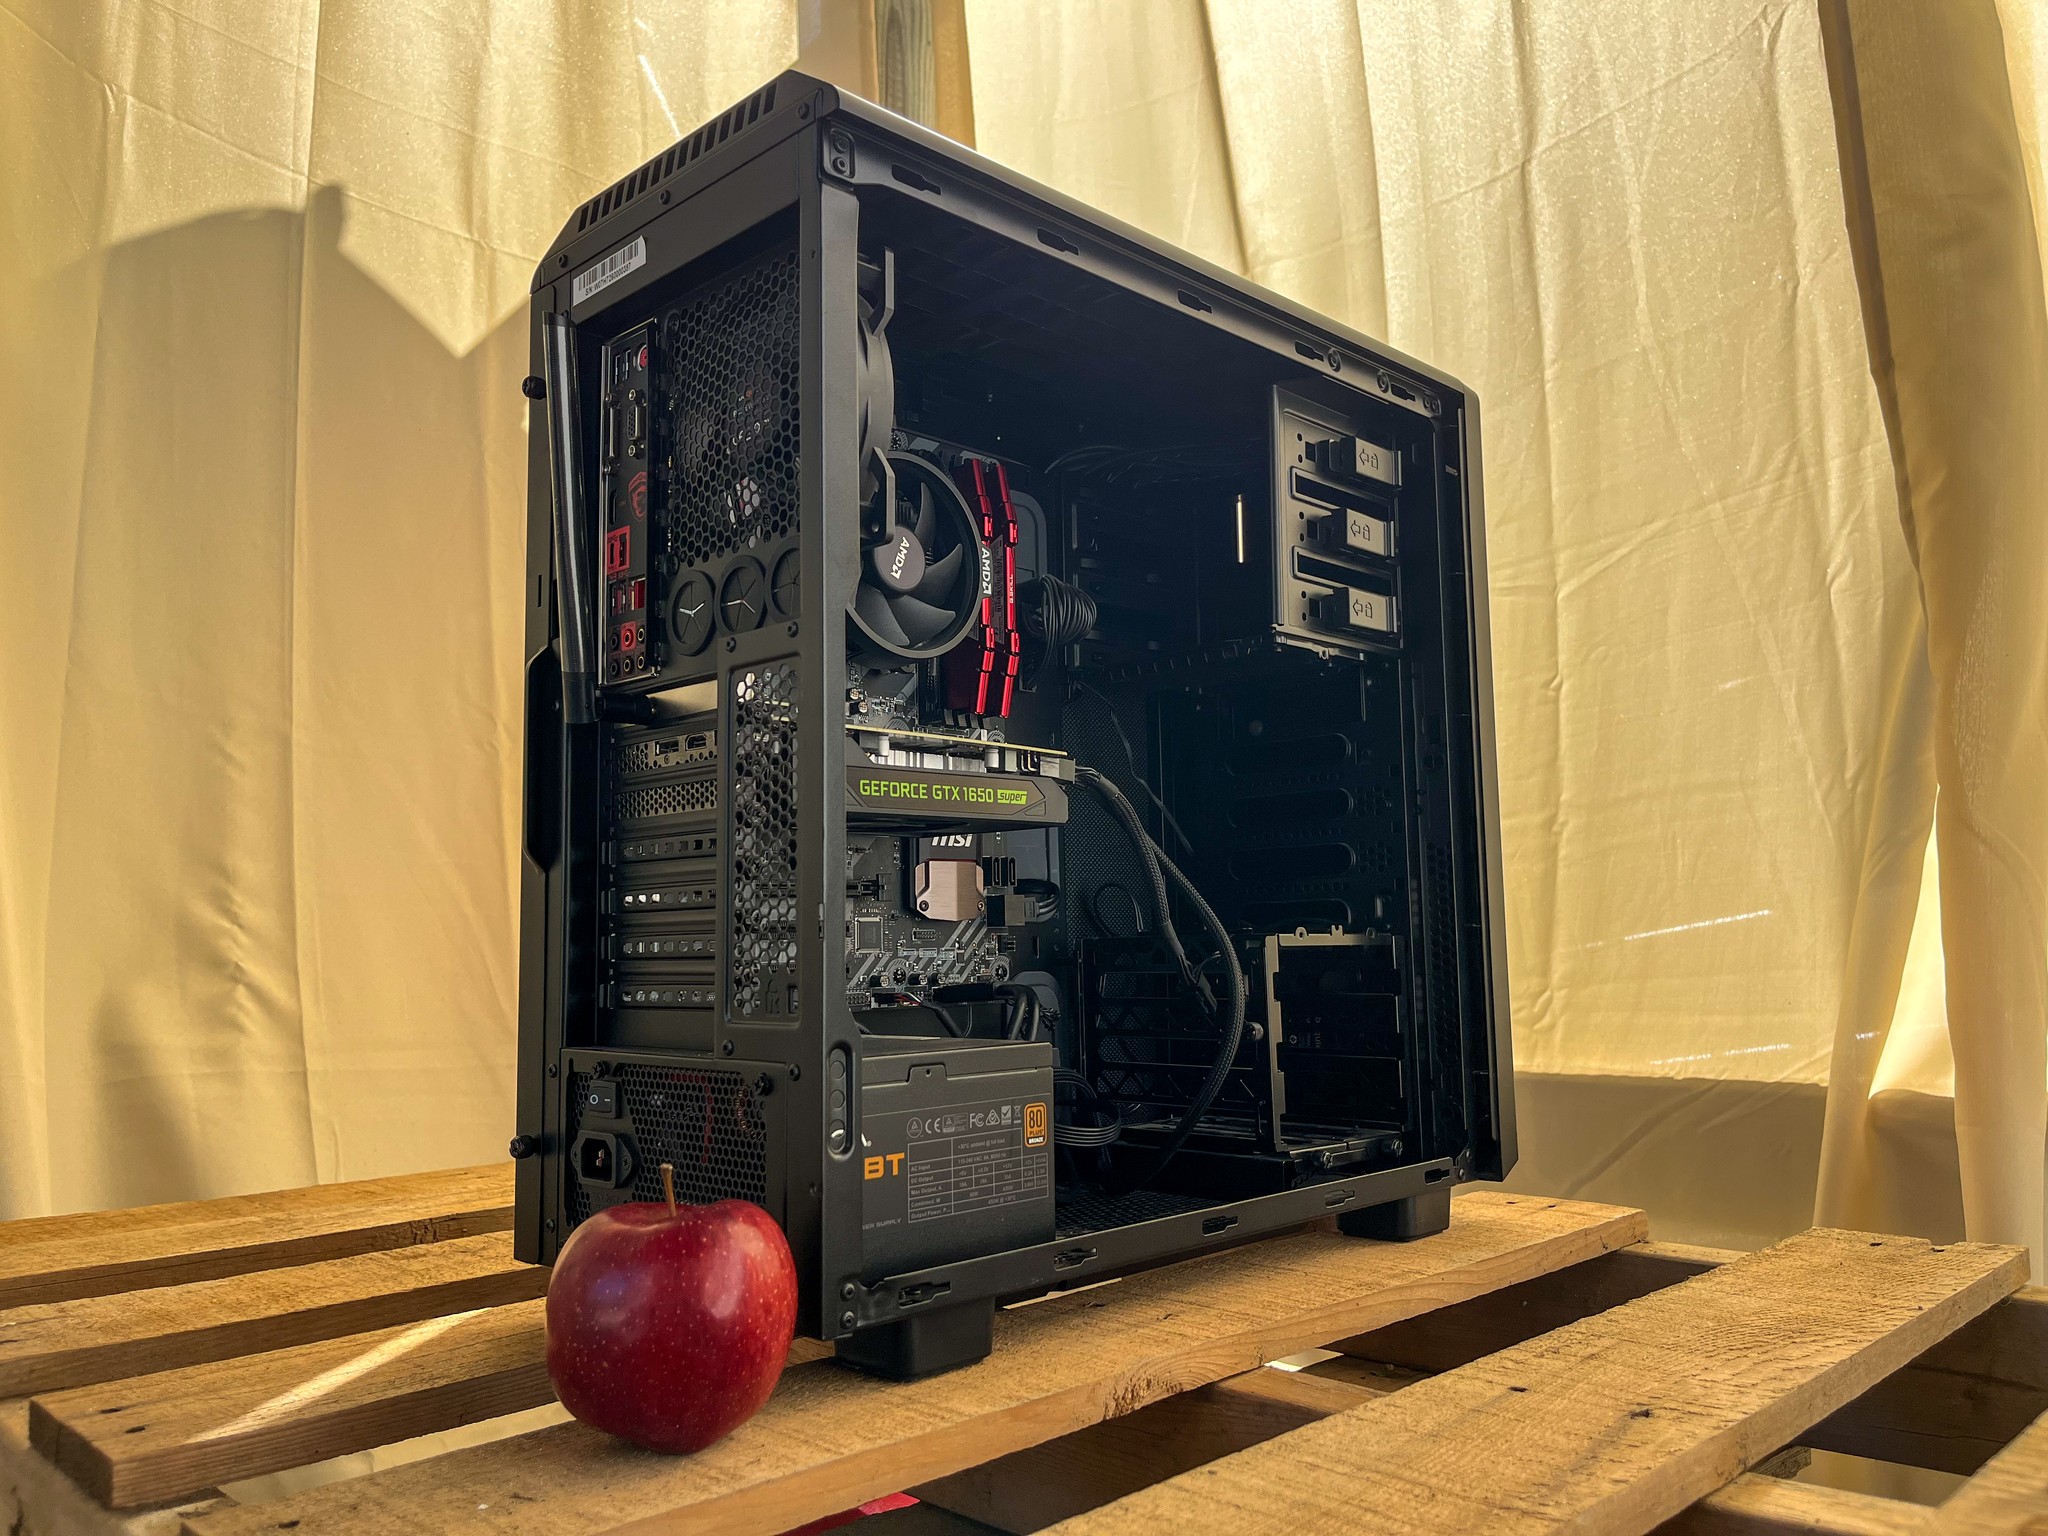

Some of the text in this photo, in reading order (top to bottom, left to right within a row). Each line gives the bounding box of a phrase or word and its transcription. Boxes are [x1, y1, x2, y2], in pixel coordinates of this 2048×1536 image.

[859, 779, 1026, 804] GEFORCE GTX 1650 super
[1029, 1109, 1042, 1128] 80
[864, 1152, 905, 1180] BT
[876, 1217, 902, 1228] SUPPLY
